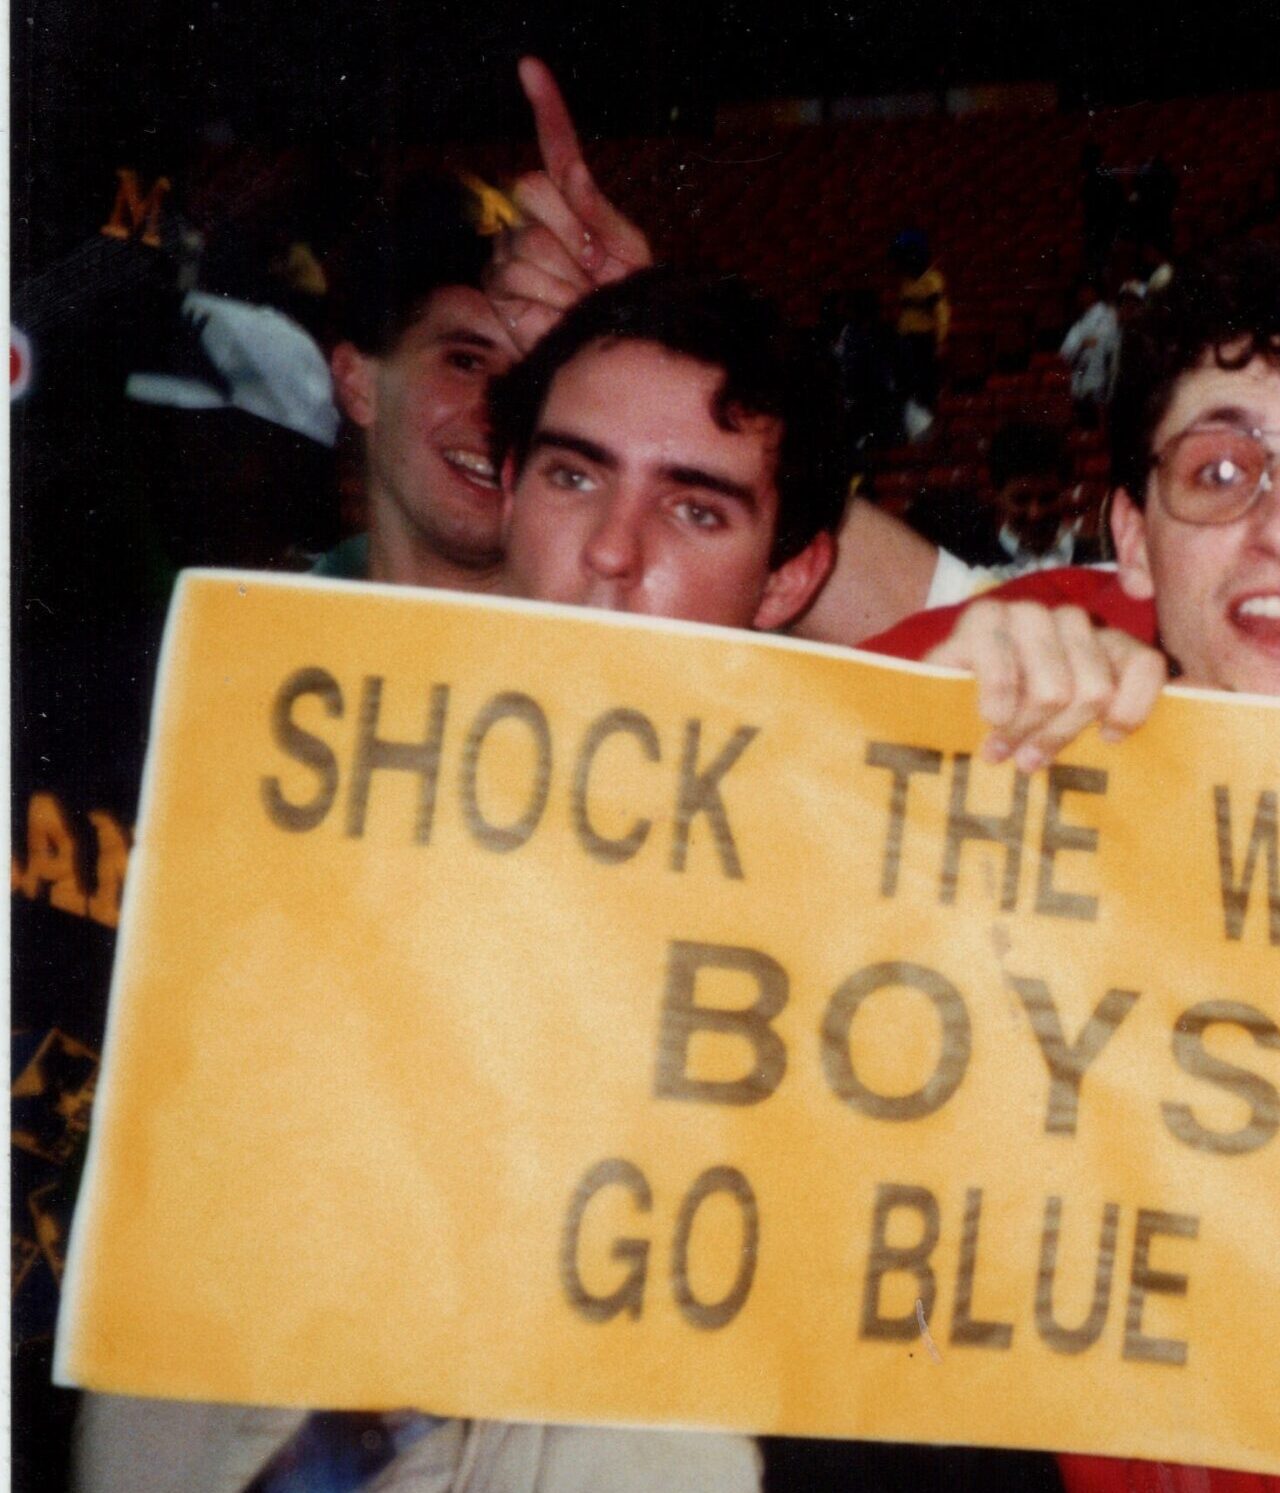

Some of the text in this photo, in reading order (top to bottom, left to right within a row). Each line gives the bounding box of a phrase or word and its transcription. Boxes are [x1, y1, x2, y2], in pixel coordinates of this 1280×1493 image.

[100, 165, 172, 249] M
[259, 665, 761, 881] SHOCK
[864, 740, 1109, 923] THE
[557, 1157, 760, 1331] GO
[857, 1181, 1200, 1367] BLUE
